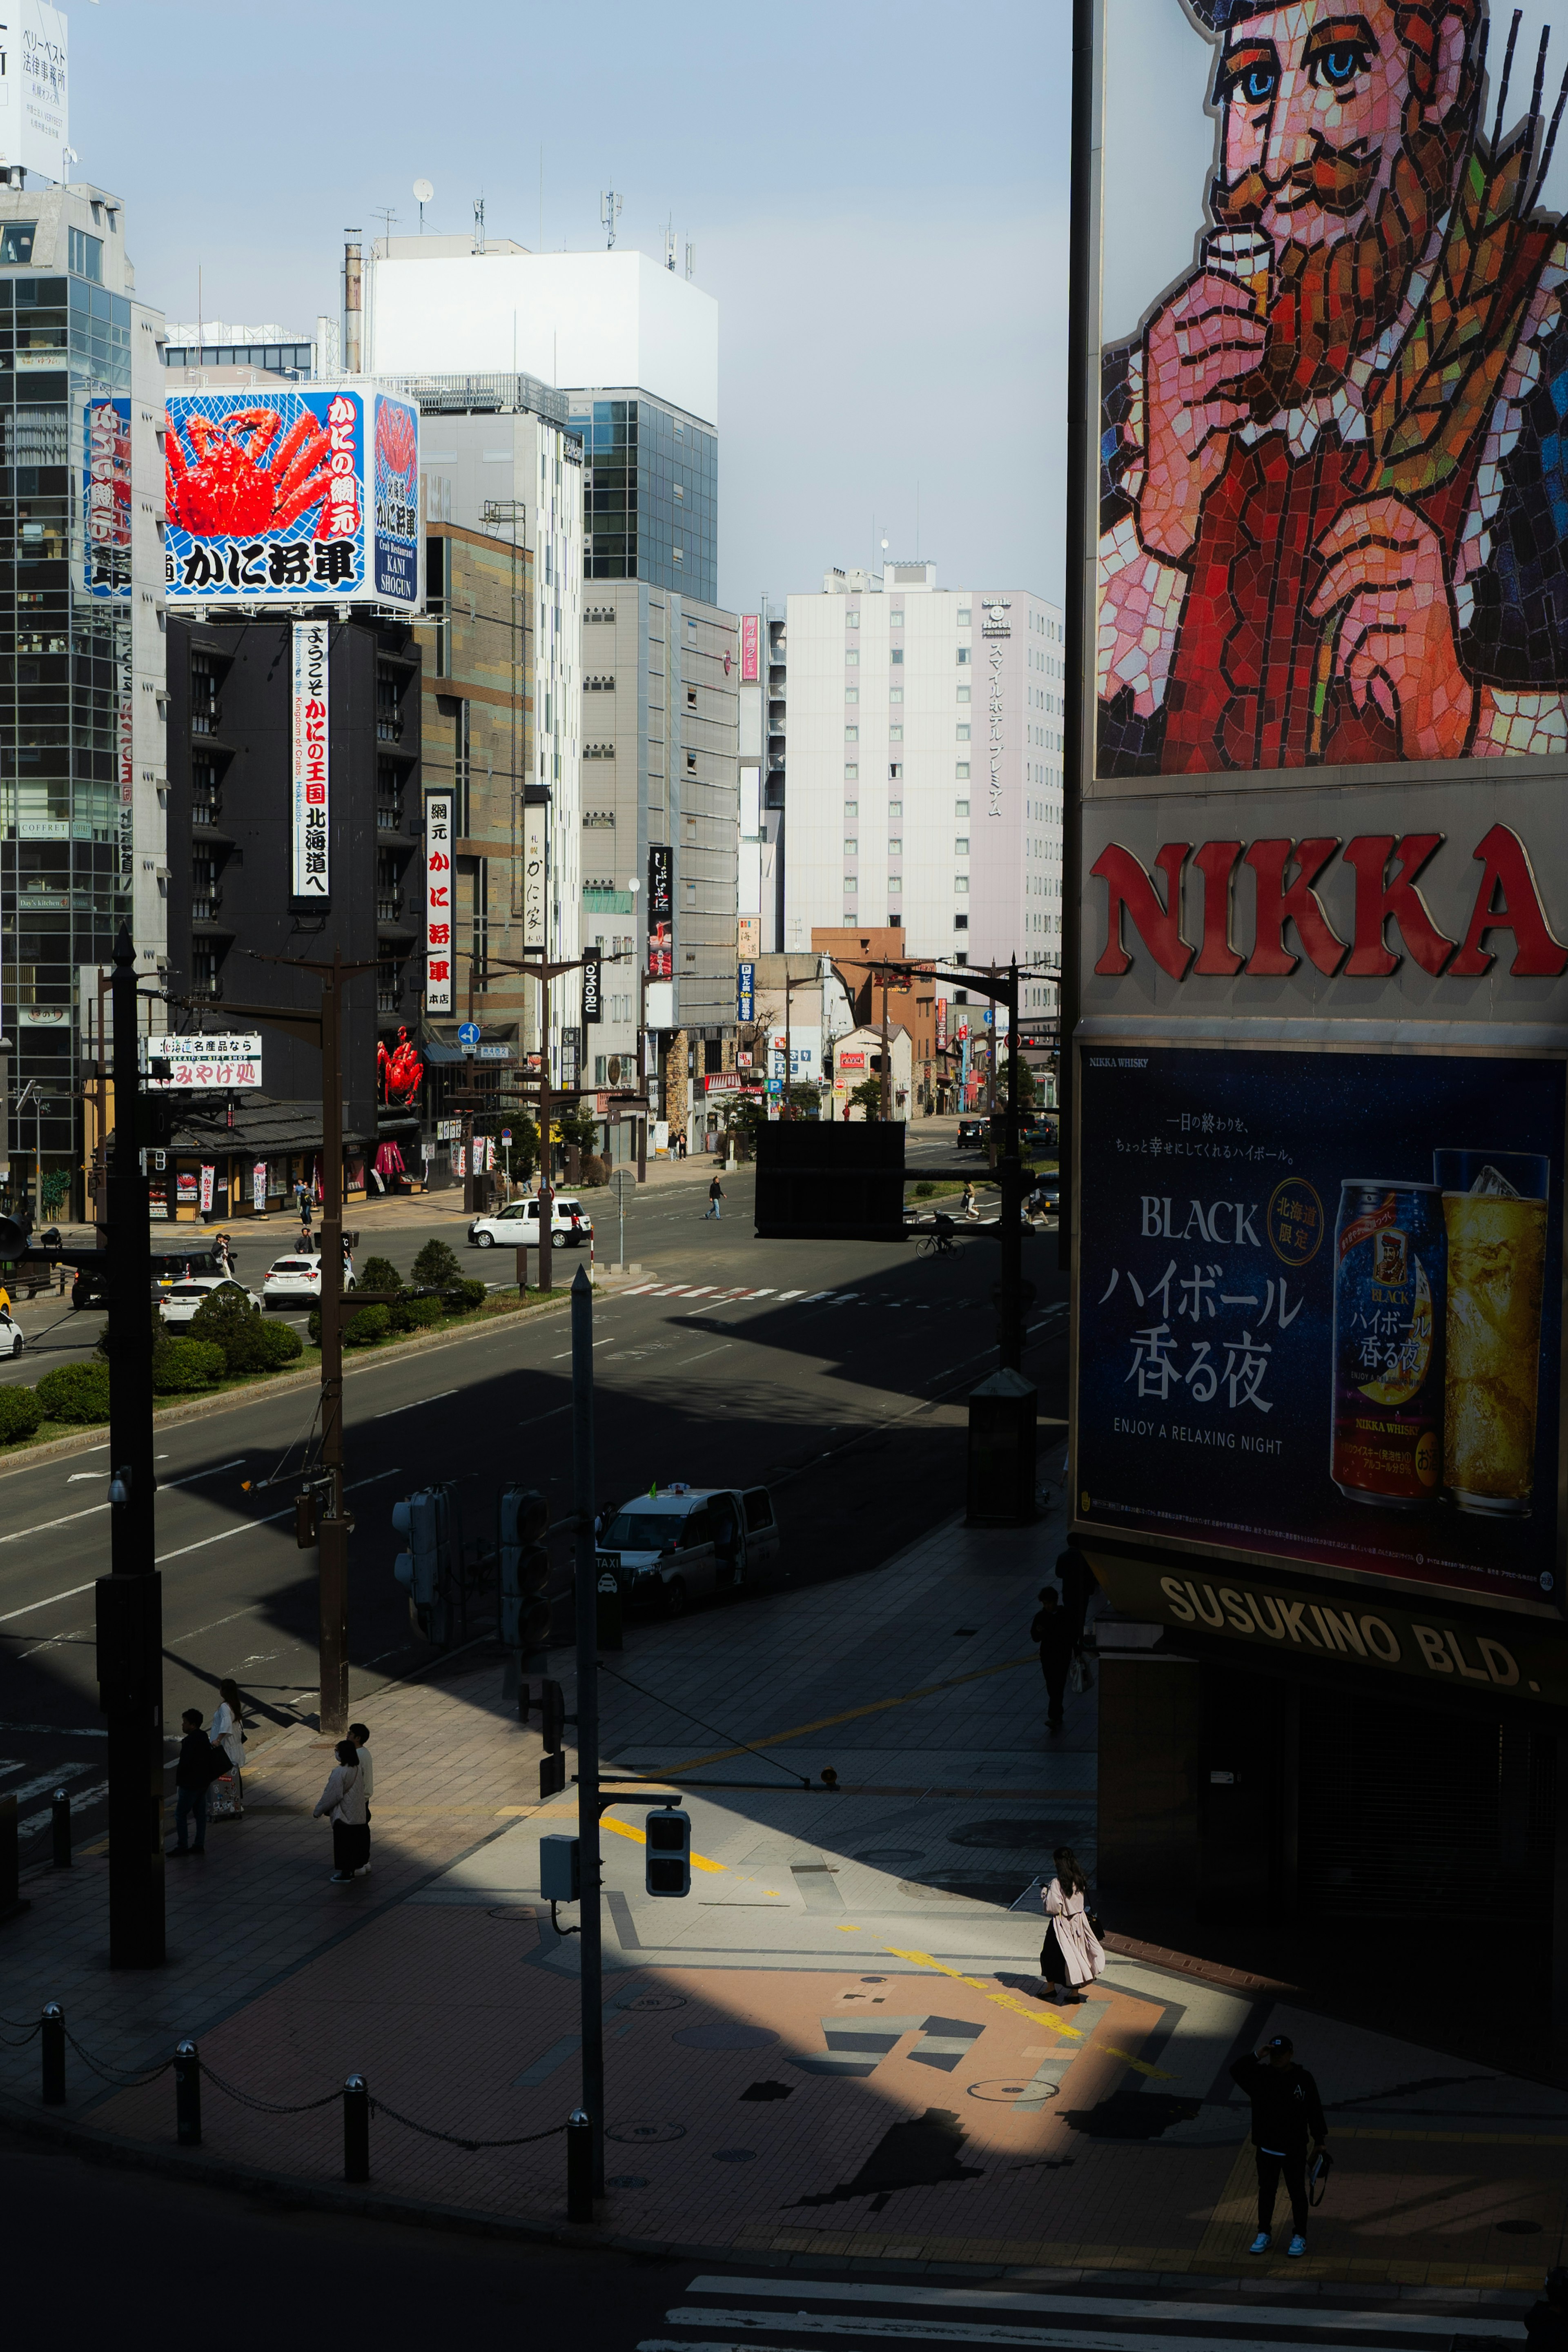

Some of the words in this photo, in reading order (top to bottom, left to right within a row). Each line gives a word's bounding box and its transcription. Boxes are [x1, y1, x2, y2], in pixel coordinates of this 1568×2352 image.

[23, 29, 65, 66] ベリーベスト
[23, 51, 65, 91] 法律事務所
[32, 82, 57, 105] 札幌オフィス
[44, 111, 62, 127] VERYBEST
[329, 396, 356, 534] かにの網元
[388, 479, 405, 501] 北海道
[377, 501, 416, 537] かに将軍
[379, 541, 390, 551] Crab
[391, 543, 413, 559] Restaurant
[387, 556, 405, 577] KANI
[381, 575, 412, 599] SHOGUN
[983, 597, 1012, 606] Smile
[983, 620, 1011, 628] Hotel
[746, 617, 755, 673] 南4西2ビル
[296, 668, 301, 677] to
[73, 824, 90, 833] COFFRET
[431, 803, 448, 840] 網元
[530, 835, 538, 855] 札幌
[527, 860, 543, 929] かに家
[1089, 822, 1568, 981] NIKKA
[429, 851, 450, 982] かに将軍
[429, 994, 449, 1004] 本店
[160, 1039, 251, 1054] 北海道名産品なら
[156, 1063, 255, 1084] みやげ処
[1089, 1058, 1117, 1067] NIKKA
[1118, 1058, 1149, 1068] WHISKY
[771, 1081, 780, 1091] P
[1167, 1112, 1248, 1134] 一日の終わりを、
[1116, 1136, 1293, 1165] ちょっと幸せにしてくれるハイボール。
[1140, 1196, 1262, 1247] BLACK
[1276, 1196, 1317, 1227] 北海道
[1279, 1223, 1308, 1250] 限定
[1098, 1259, 1305, 1330] ハイボール
[1372, 1288, 1408, 1305] BLACK
[1350, 1309, 1430, 1338] ハイボール
[1359, 1335, 1420, 1372] 香る夜
[1124, 1322, 1274, 1414] 香る夜
[1351, 1371, 1368, 1381] ENJOY
[1114, 1417, 1156, 1434] ENJOY
[1158, 1423, 1168, 1435] A
[1172, 1424, 1236, 1449] RELAXING
[1241, 1435, 1283, 1455] NIGHT
[1356, 1418, 1385, 1432] NIKKA
[1386, 1423, 1420, 1437] WHISKY
[1363, 1458, 1412, 1475] アルコール分9%
[595, 1558, 619, 1568] TAXI
[1160, 1576, 1401, 1663] SUSUKINO
[1412, 1623, 1542, 1693] BLD.
